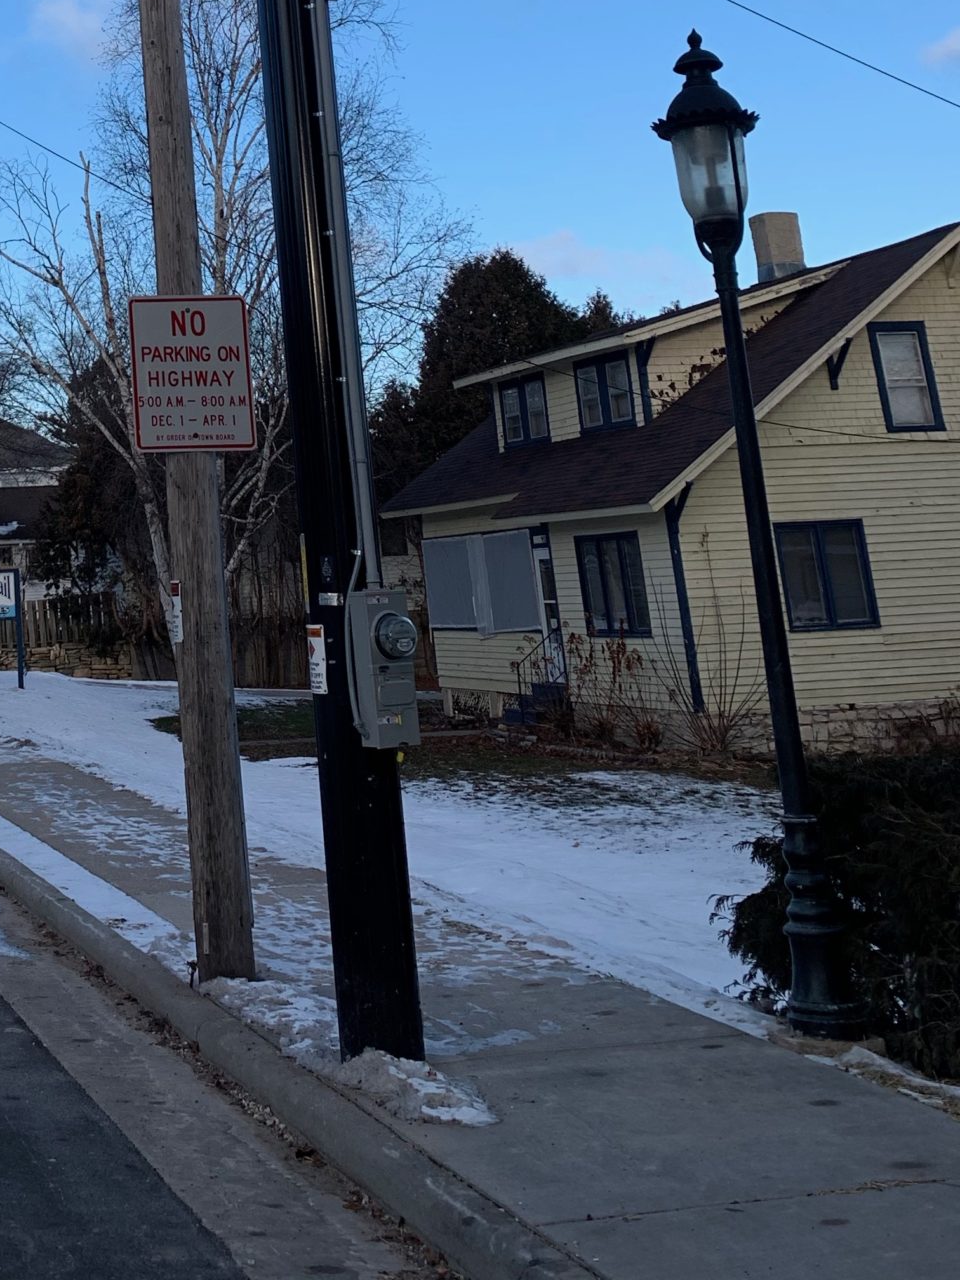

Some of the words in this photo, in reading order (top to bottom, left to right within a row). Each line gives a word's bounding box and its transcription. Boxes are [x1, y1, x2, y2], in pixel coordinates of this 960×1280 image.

[170, 310, 206, 337] NO
[141, 346, 211, 363] PARKING
[217, 345, 240, 362] ON
[148, 370, 235, 388] HIGHWAY
[201, 396, 225, 407] 8:00
[151, 415, 175, 427] DEC.
[180, 415, 184, 426] 1
[203, 414, 227, 426] APR.
[232, 414, 236, 426] 1
[156, 434, 164, 442] BY
[167, 434, 186, 442] ORDER
[215, 433, 235, 441] BOARD
